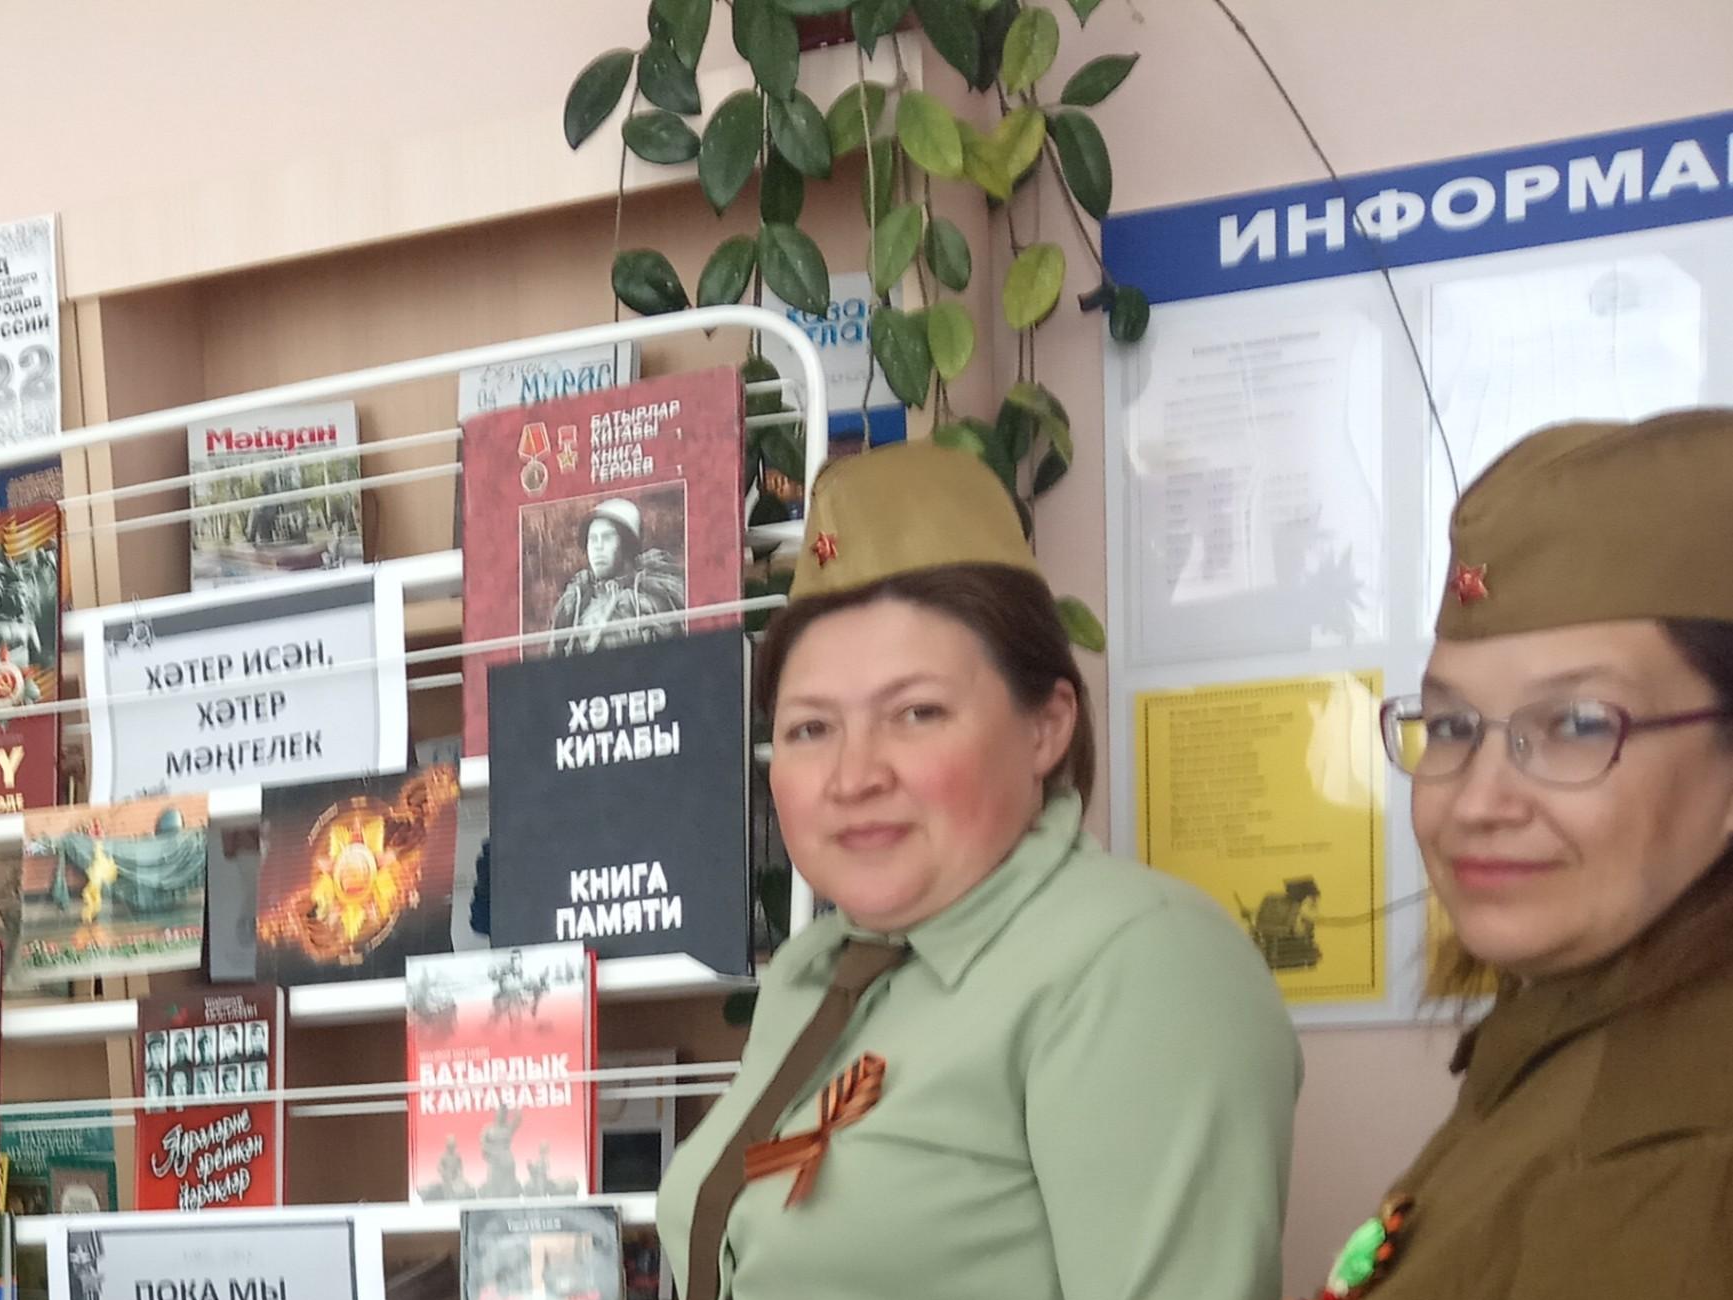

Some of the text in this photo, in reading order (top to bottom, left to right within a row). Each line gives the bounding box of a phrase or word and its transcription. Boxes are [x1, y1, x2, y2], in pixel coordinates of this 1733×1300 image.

[1218, 134, 1733, 267] ИНФОРМА
[591, 400, 680, 428] БАТЫРЛАР
[591, 420, 657, 446] КИТАБЫ
[205, 424, 337, 455] Мәйдан
[591, 443, 642, 464] КНИГА
[591, 456, 653, 485] ГЕРОЕВ
[145, 638, 334, 693] ХӘТЕР ИСӘН,
[197, 690, 286, 731] ХӘТЕР
[568, 688, 666, 733] ХӘТЕР
[167, 729, 323, 779] МӘҢГЕЛЕК
[556, 721, 680, 771] КИТАБЫ
[570, 861, 668, 903] КНИГА
[556, 896, 682, 940] ПАМЯТИ
[419, 1053, 569, 1087] БАТЫРЛЫК
